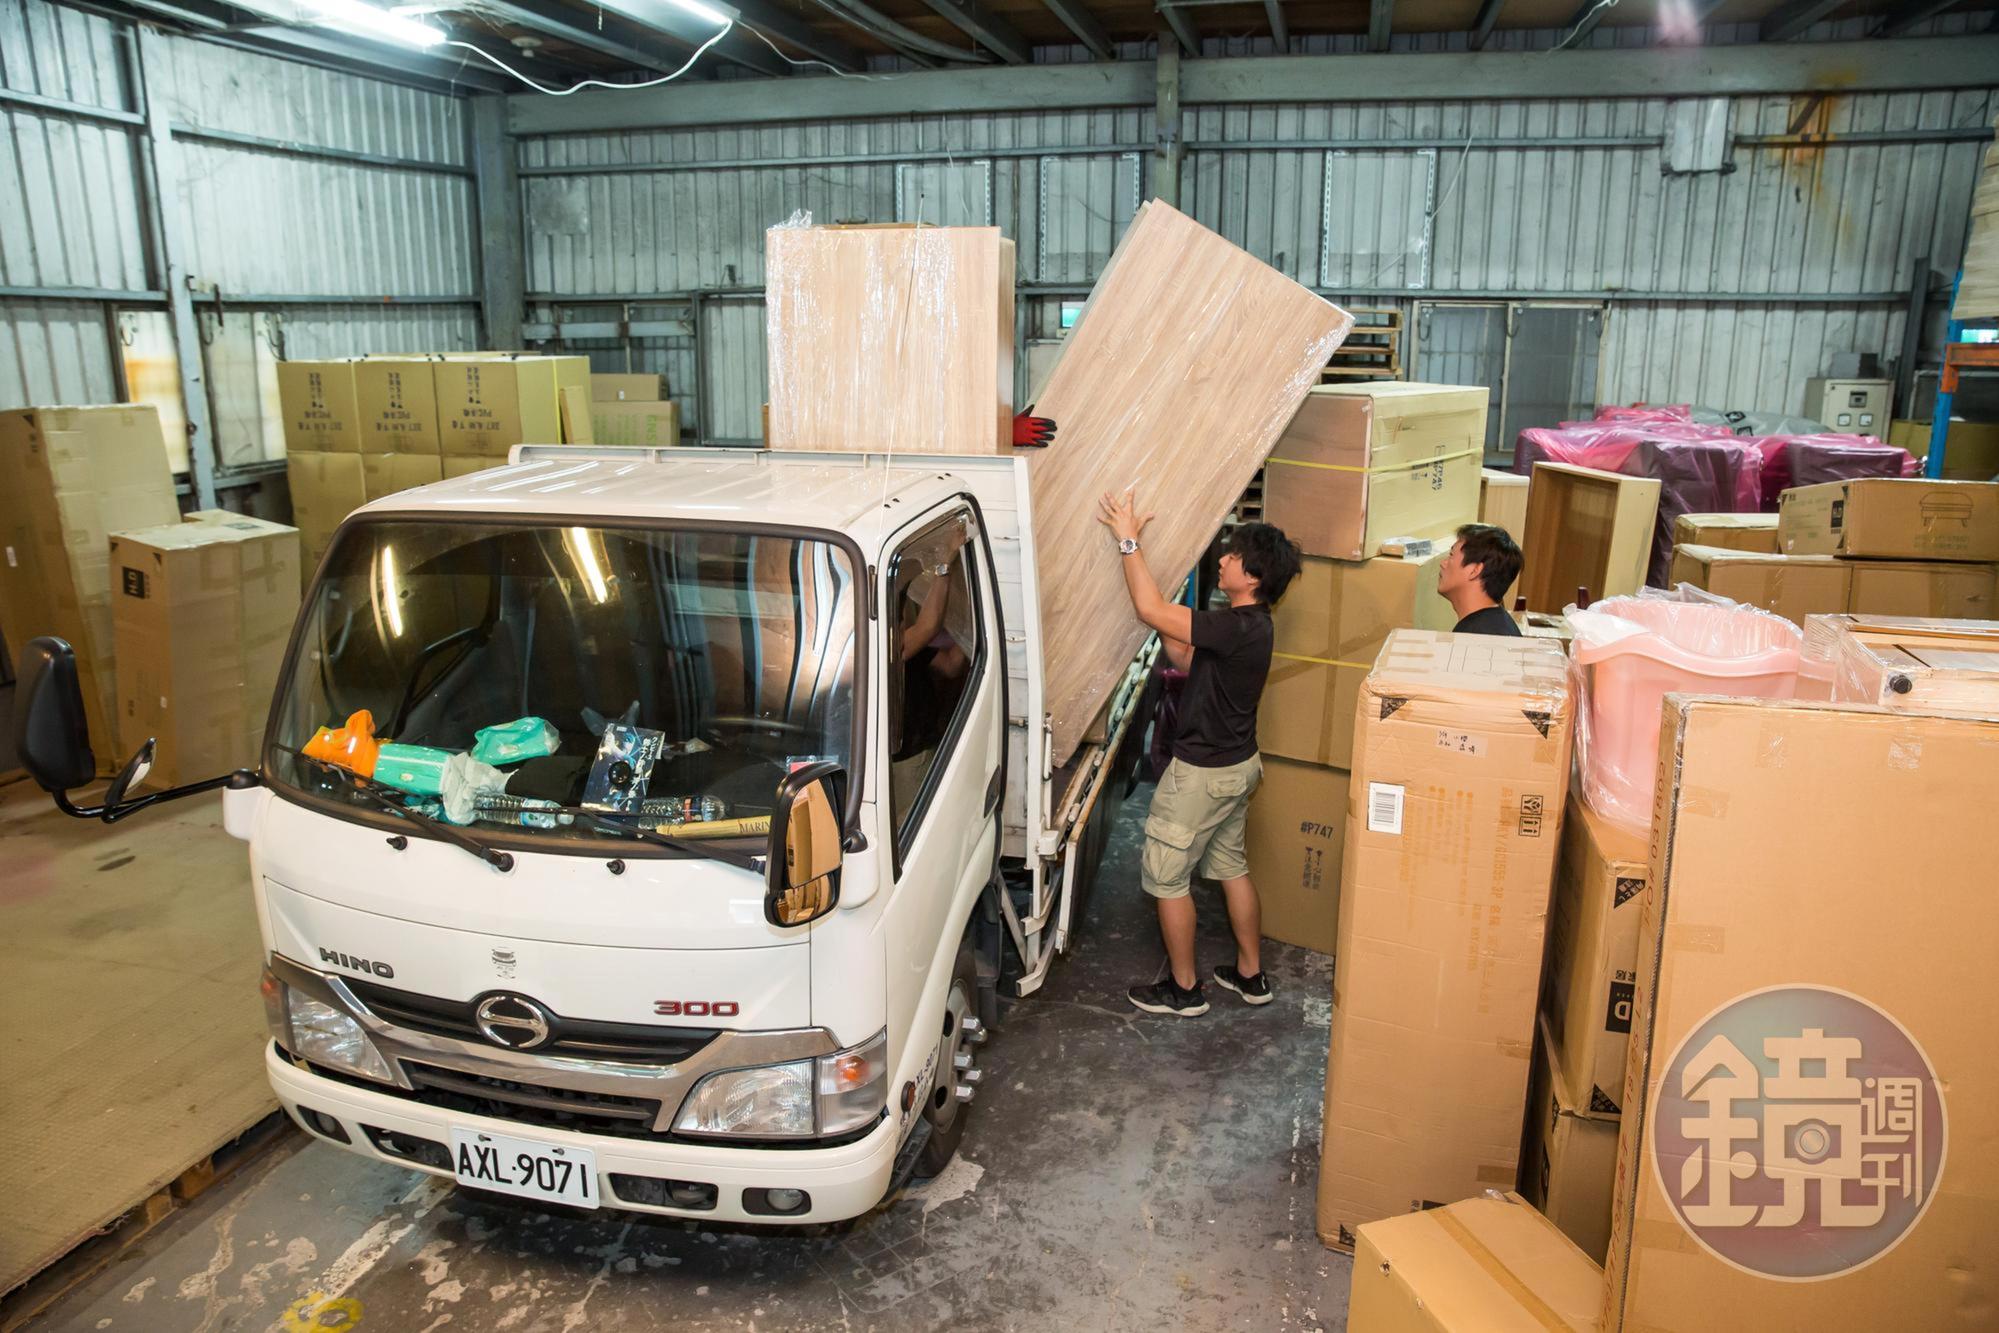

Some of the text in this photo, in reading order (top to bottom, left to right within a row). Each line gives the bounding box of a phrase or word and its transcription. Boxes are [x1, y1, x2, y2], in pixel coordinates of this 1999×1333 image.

[1301, 821, 1334, 839] #P747
[319, 946, 394, 979] HINO
[654, 1000, 740, 1017] 300
